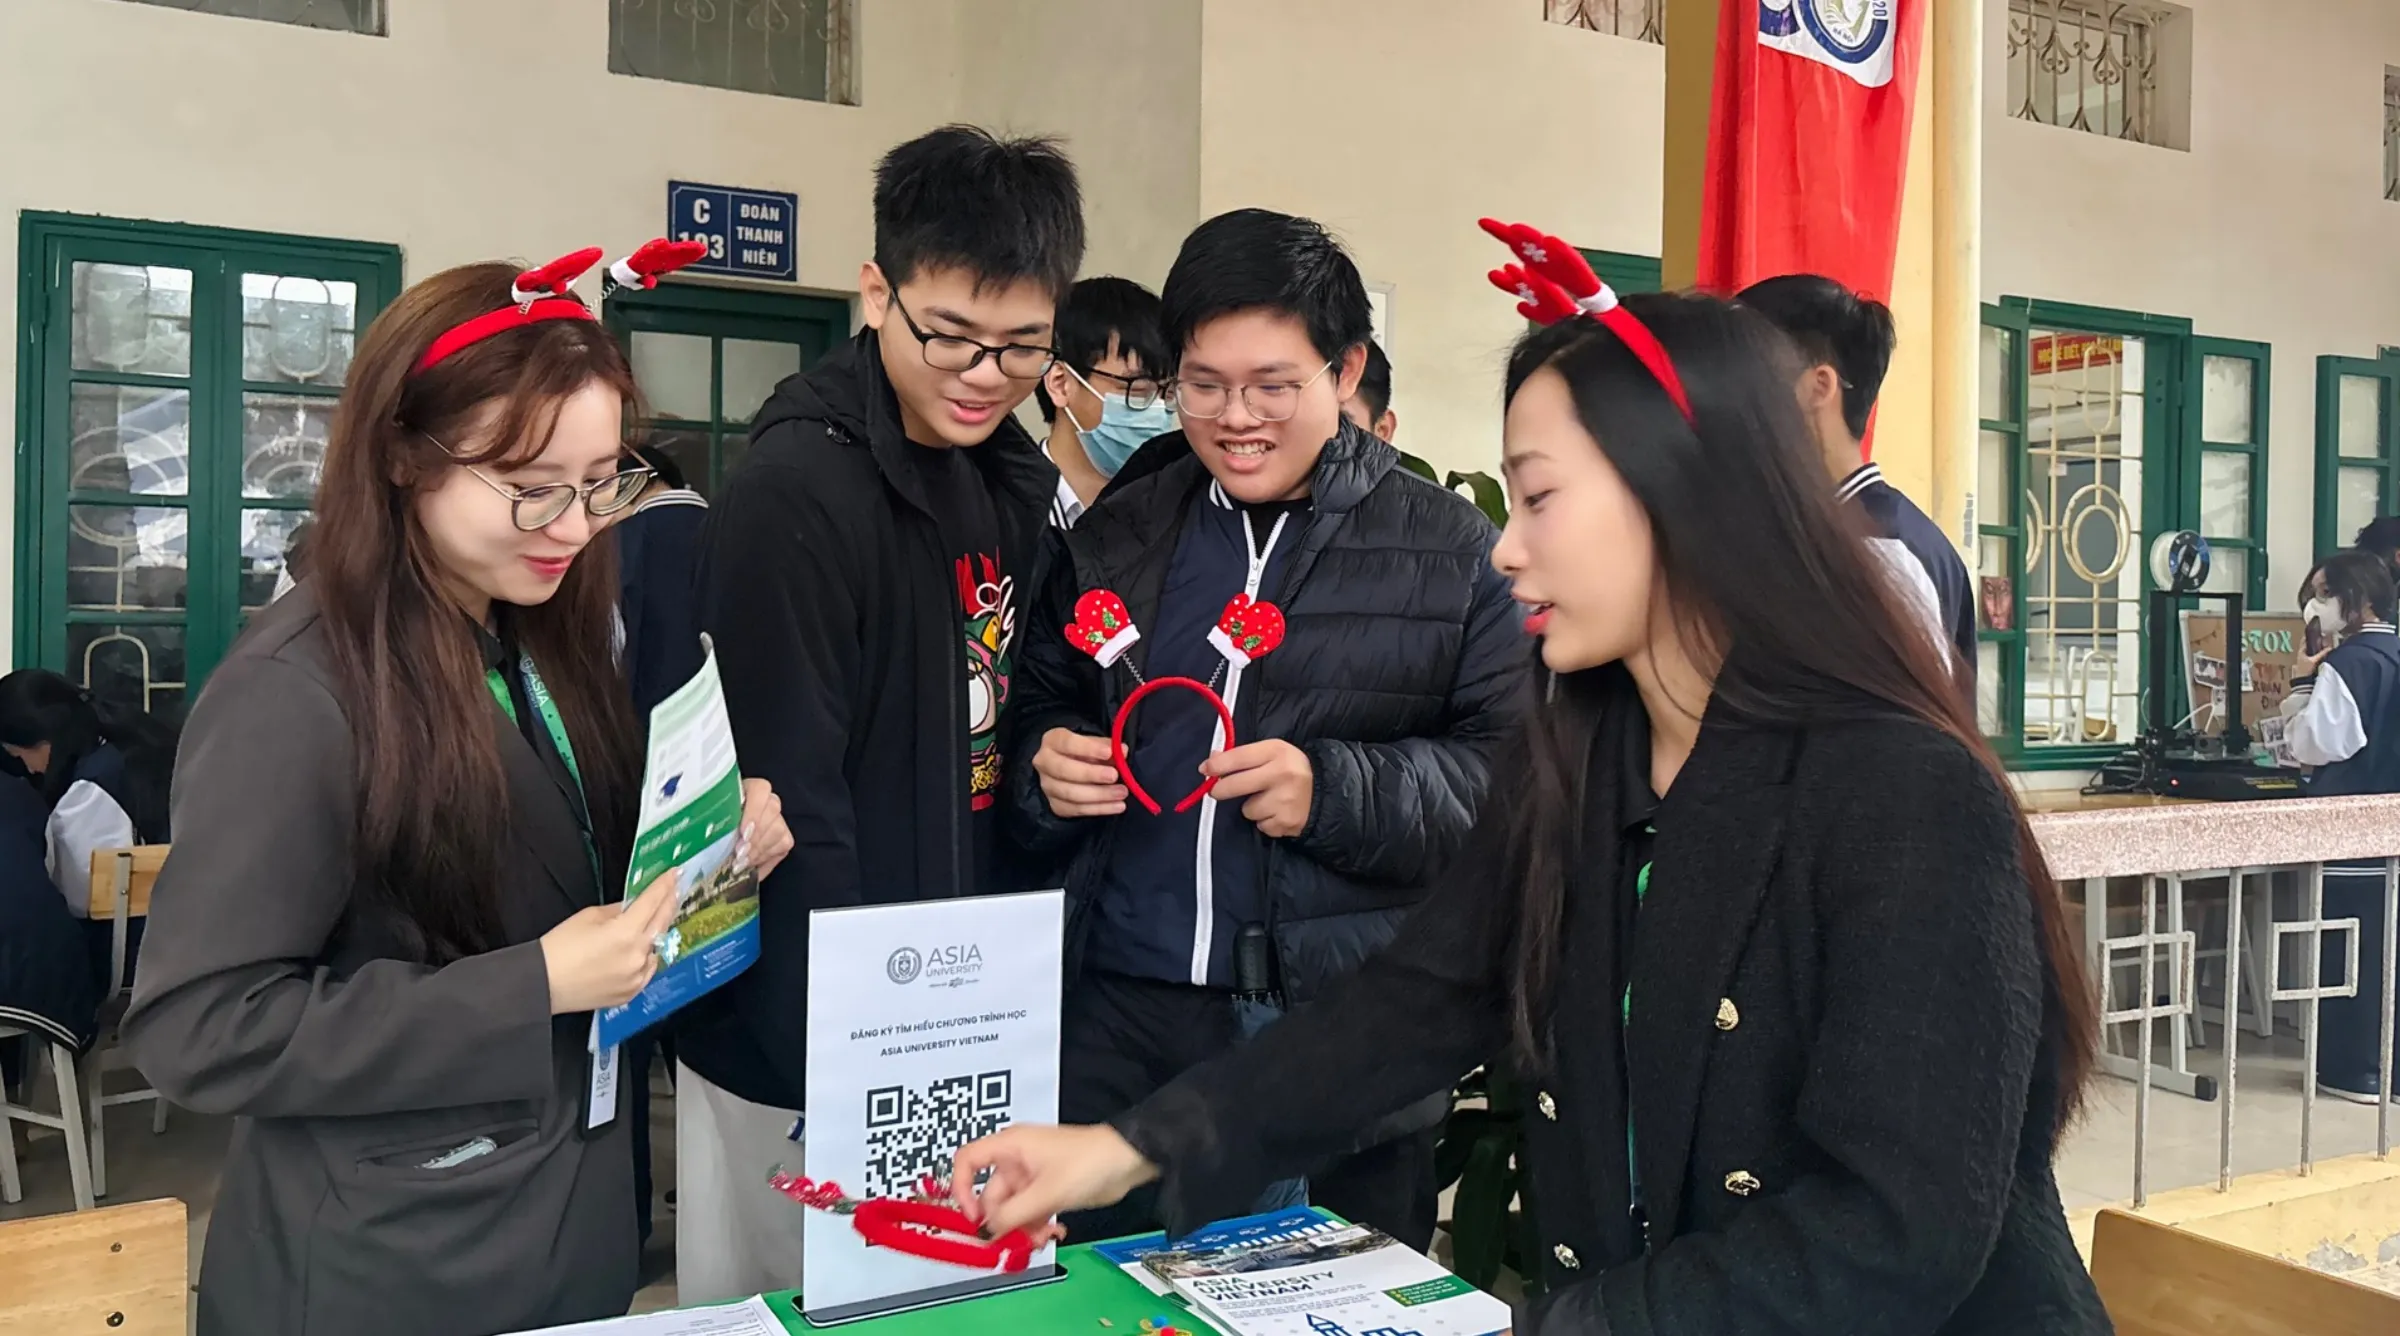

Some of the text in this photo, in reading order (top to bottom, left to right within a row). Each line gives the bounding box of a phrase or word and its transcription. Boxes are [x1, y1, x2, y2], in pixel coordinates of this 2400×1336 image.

[692, 198, 711, 224] C
[740, 202, 780, 222] ĐOÀN
[736, 225, 784, 245] THANH
[742, 247, 777, 266] NIÊN
[528, 674, 550, 708] ASIA
[927, 943, 983, 967] ASIA
[926, 962, 983, 977] UNIVERSITY
[850, 1009, 1027, 1041] ĐĂNG KÝ TÌM HIỂU CHƯƠNG TRÌNH HỌC
[880, 1033, 999, 1057] ASIA UNIVERSITY VIETNAM
[1192, 1277, 1249, 1288] ASIA
[1199, 1270, 1336, 1294] UNIVERSITY
[1206, 1283, 1314, 1301] VIETNAM
